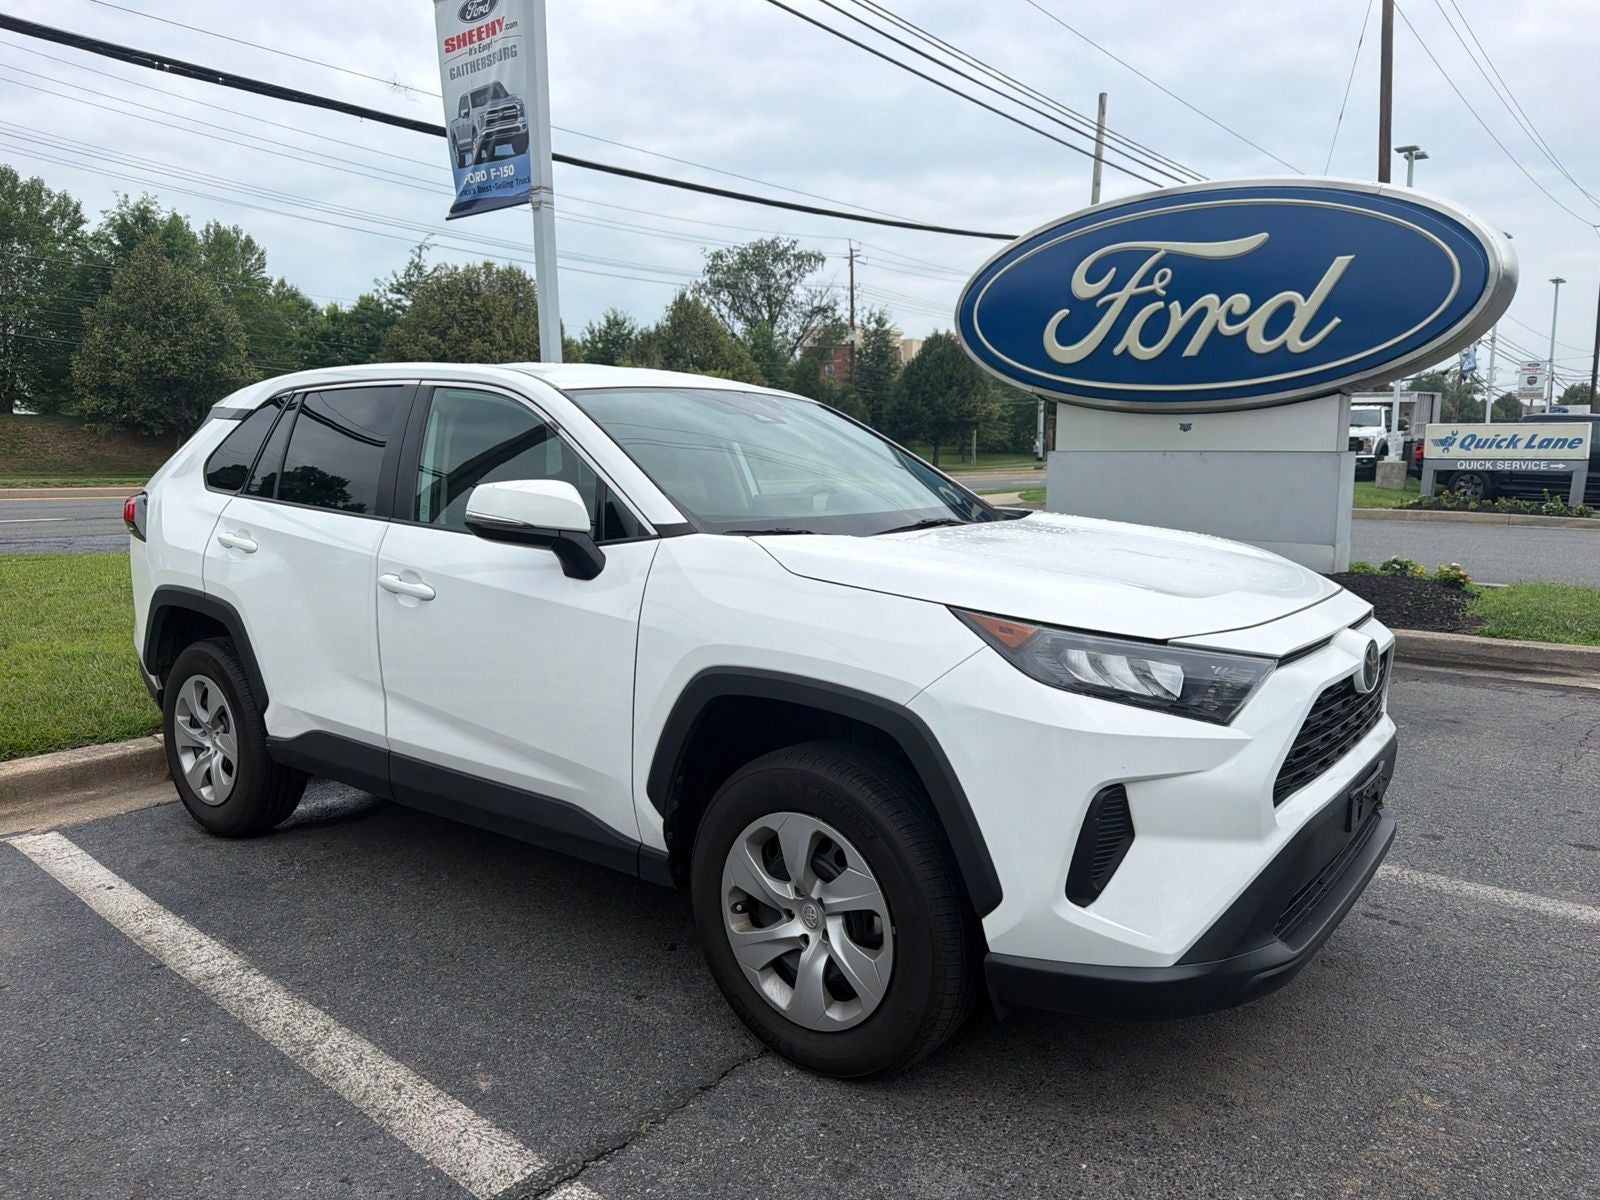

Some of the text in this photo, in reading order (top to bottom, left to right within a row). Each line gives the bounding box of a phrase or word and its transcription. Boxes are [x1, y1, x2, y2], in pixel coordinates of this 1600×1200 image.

[465, 0, 490, 19] Ford
[468, 38, 493, 57] It's Easy!
[490, 164, 514, 179] F-150
[1042, 231, 1356, 364] Ford
[1459, 433, 1584, 451] Quick Lane
[1457, 460, 1548, 470] QUICK SERVICE
